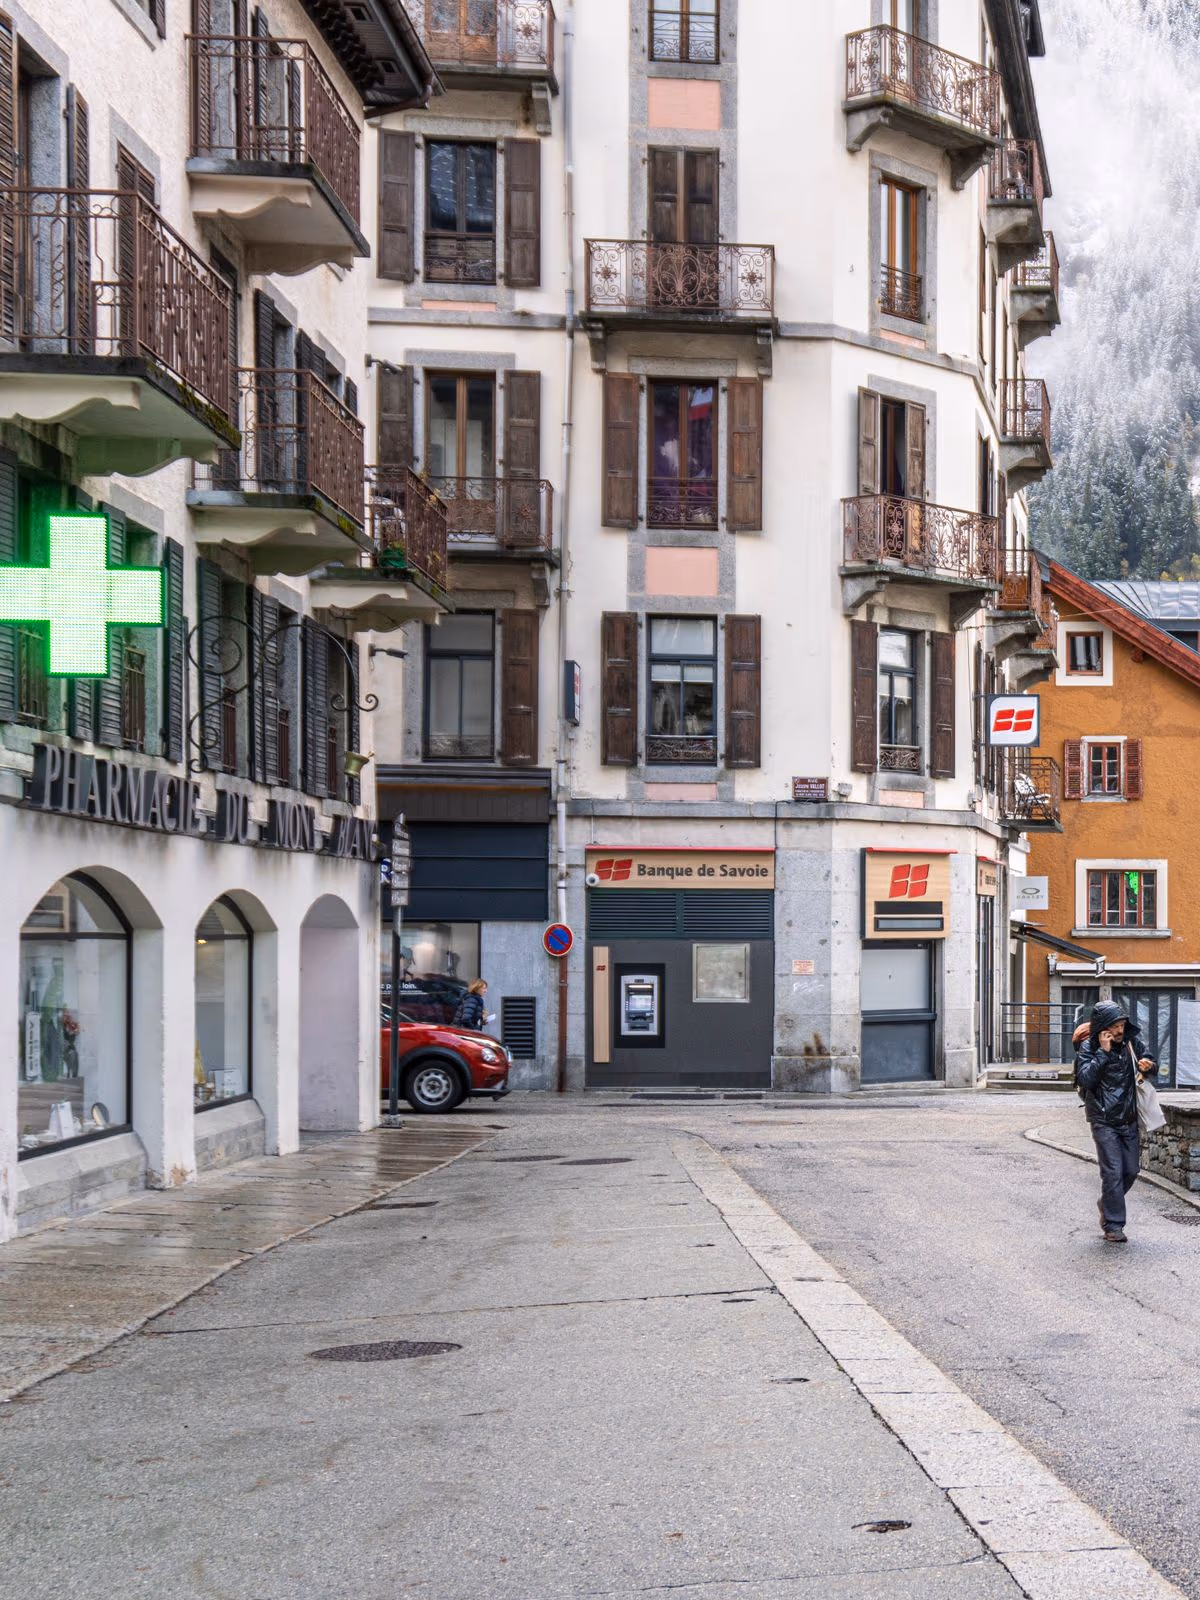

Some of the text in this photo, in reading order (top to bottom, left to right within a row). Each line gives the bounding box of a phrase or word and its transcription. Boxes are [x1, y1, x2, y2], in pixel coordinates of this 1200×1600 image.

[38, 742, 201, 833] PHARMACIE
[224, 790, 250, 844] DU
[637, 863, 769, 879] Banque de Savoie
